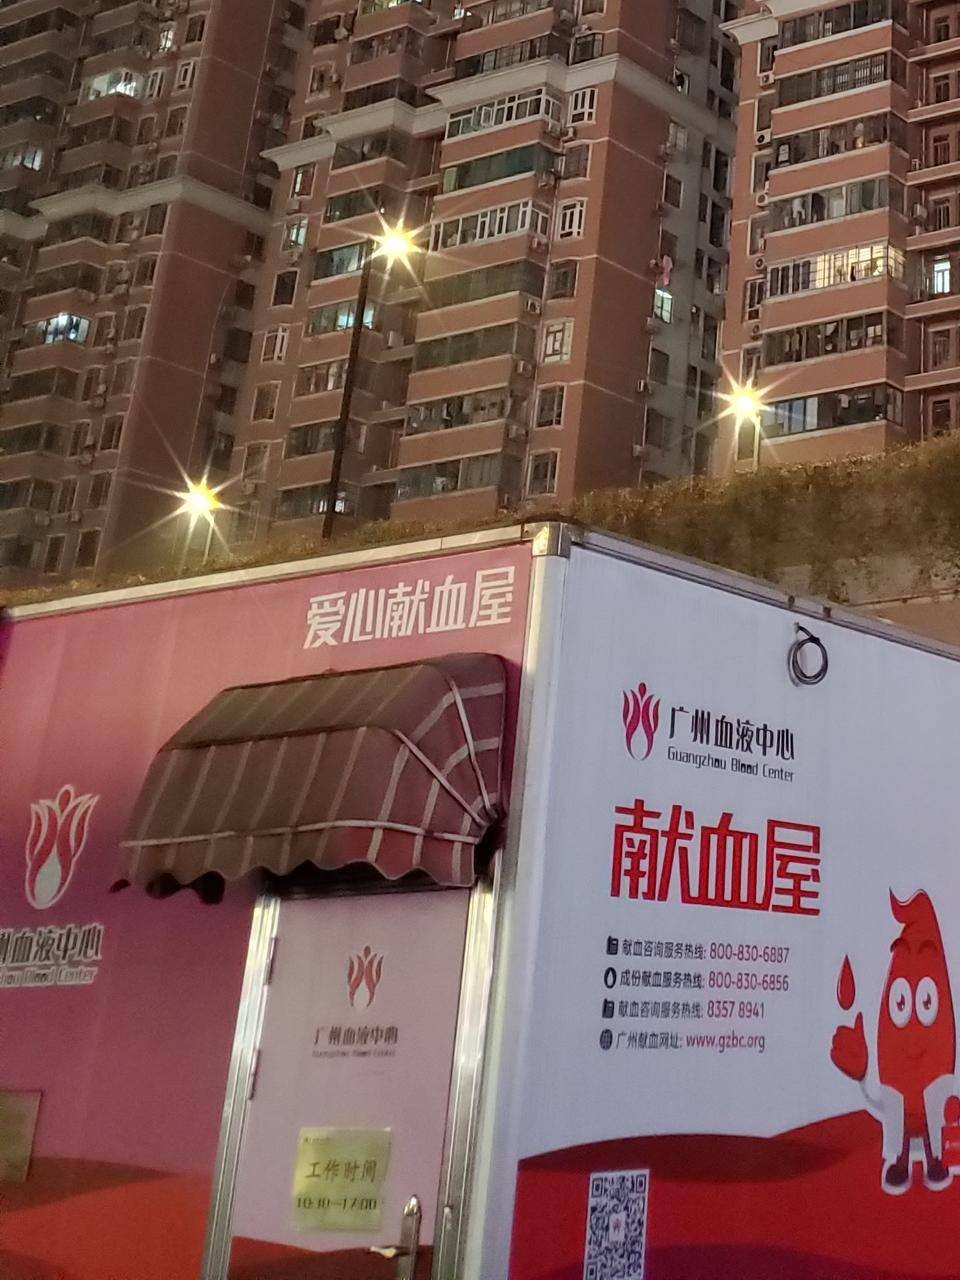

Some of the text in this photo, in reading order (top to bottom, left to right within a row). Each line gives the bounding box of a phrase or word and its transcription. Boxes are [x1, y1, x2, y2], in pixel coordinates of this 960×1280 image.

[304, 566, 515, 649] 爱心献血屋
[669, 706, 795, 761] 广州血液中心
[667, 746, 795, 783] Guangzhou Blood Center
[611, 798, 821, 916] 献血屋
[622, 938, 790, 963] 献血咨询服务热线: 800-830-6887
[620, 969, 789, 992] 成份献血服务热线: 800-830-6856
[618, 1000, 765, 1020] 献血咨询服务热线: 8357 8941
[616, 1029, 765, 1054] 广州献血网址: www.gzbc.org
[305, 1159, 377, 1182] 工作时间
